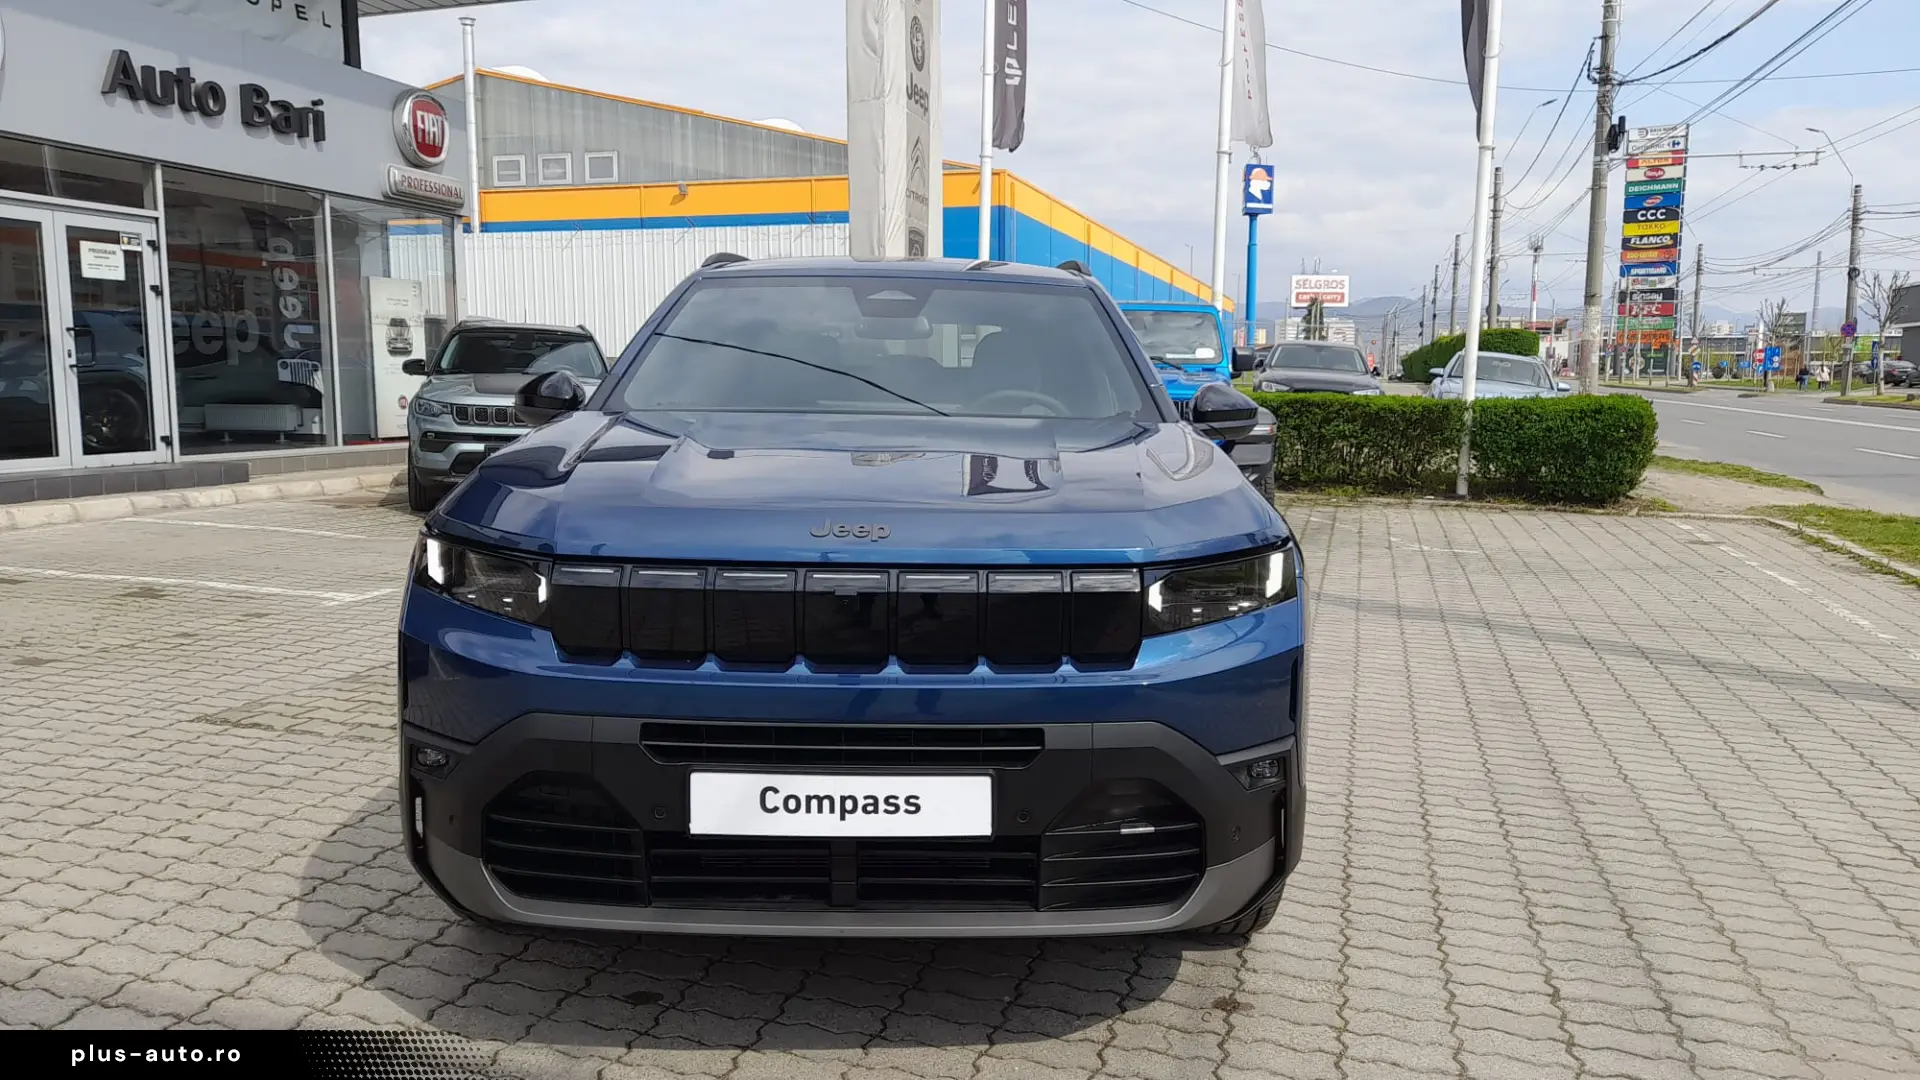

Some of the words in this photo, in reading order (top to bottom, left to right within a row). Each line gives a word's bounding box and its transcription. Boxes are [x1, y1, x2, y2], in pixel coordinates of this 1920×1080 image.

[101, 49, 226, 117] Auto
[239, 83, 326, 142] Bari
[906, 72, 929, 117] Jeep
[416, 110, 445, 147] FIAT
[401, 174, 463, 200] PROFESSIONAL
[1628, 183, 1679, 192] DEICHMANN
[1637, 209, 1666, 220] CCC
[1630, 235, 1670, 245] FLANCO
[1294, 278, 1346, 290] SELGROS
[1631, 303, 1662, 315] KFC
[809, 518, 892, 542] Jeep
[760, 785, 922, 821] Compass
